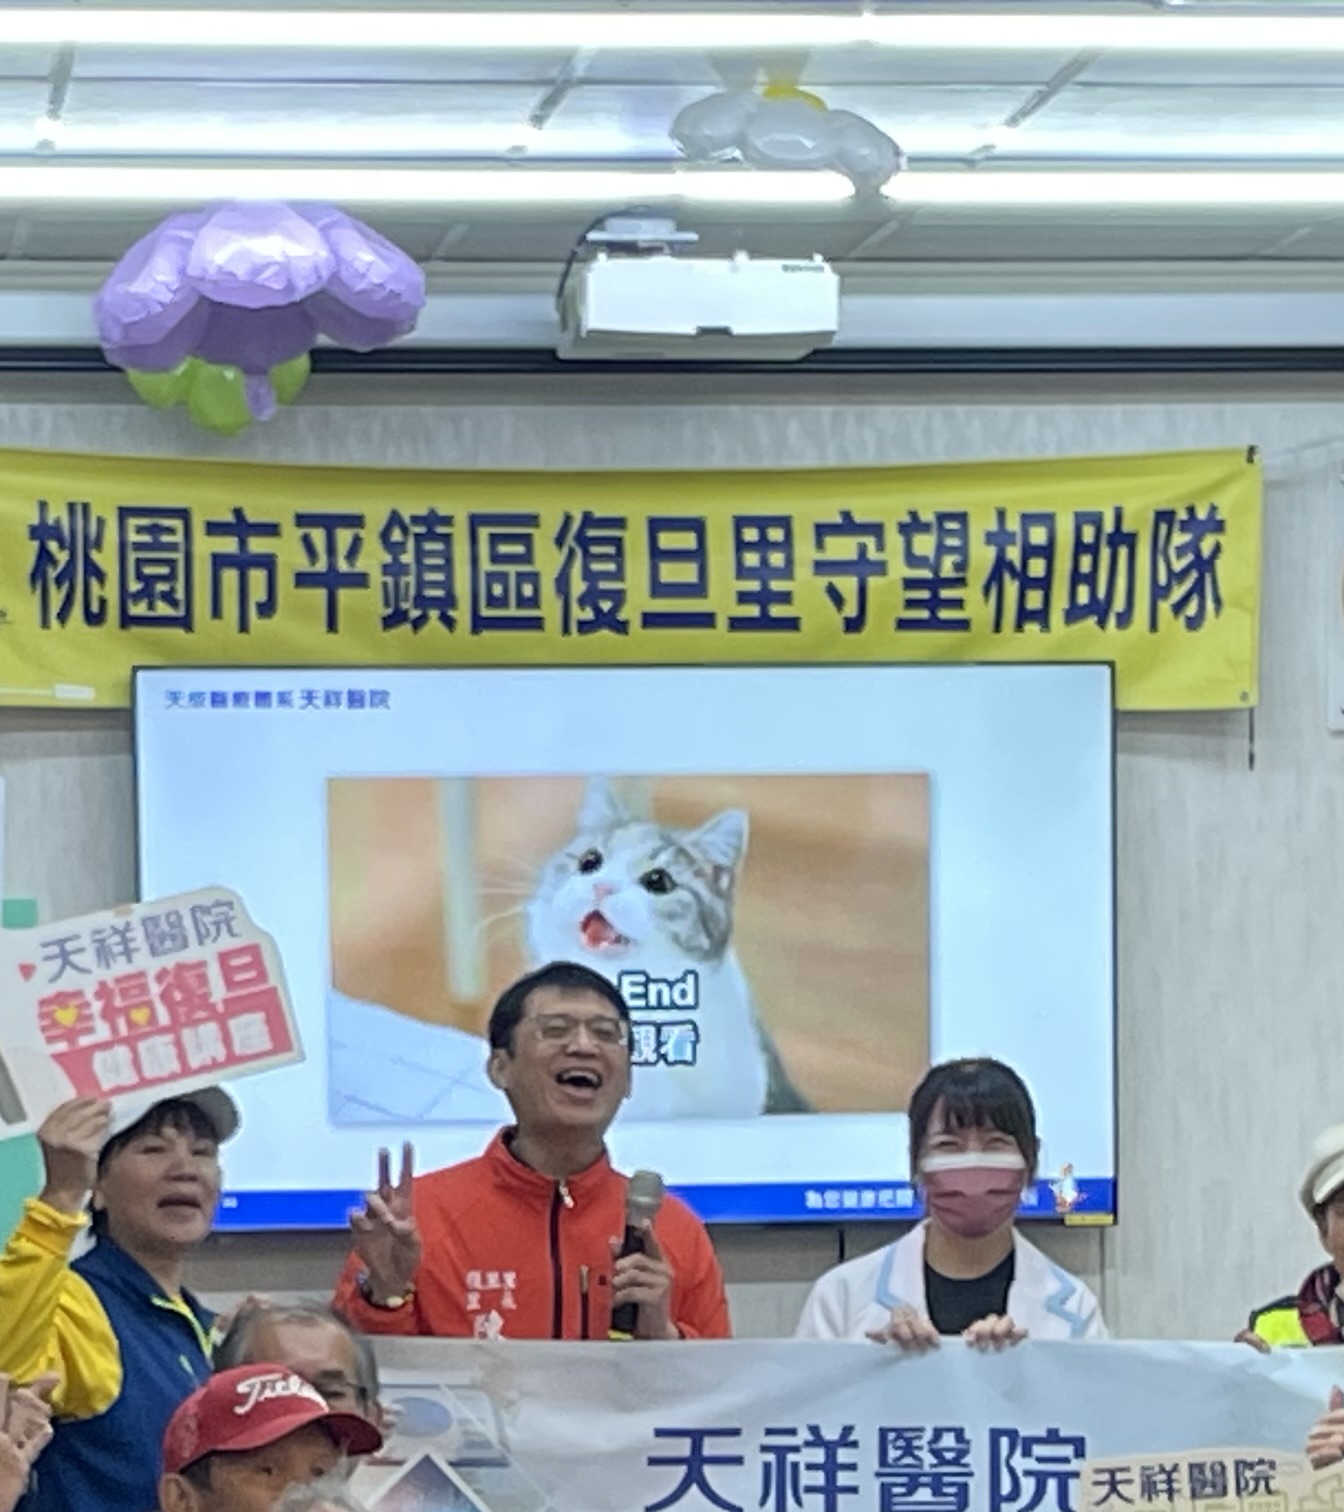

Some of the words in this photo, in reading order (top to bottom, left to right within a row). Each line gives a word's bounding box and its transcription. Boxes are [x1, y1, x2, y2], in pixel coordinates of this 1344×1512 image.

[29, 499, 1226, 634] 桃園市平鎮區復旦里守望相助隊
[39, 900, 243, 984] 天祥醫院
[33, 942, 280, 1048] 幸福復旦
[619, 970, 699, 1010] End
[1092, 1459, 1277, 1507] 天祥醫院
